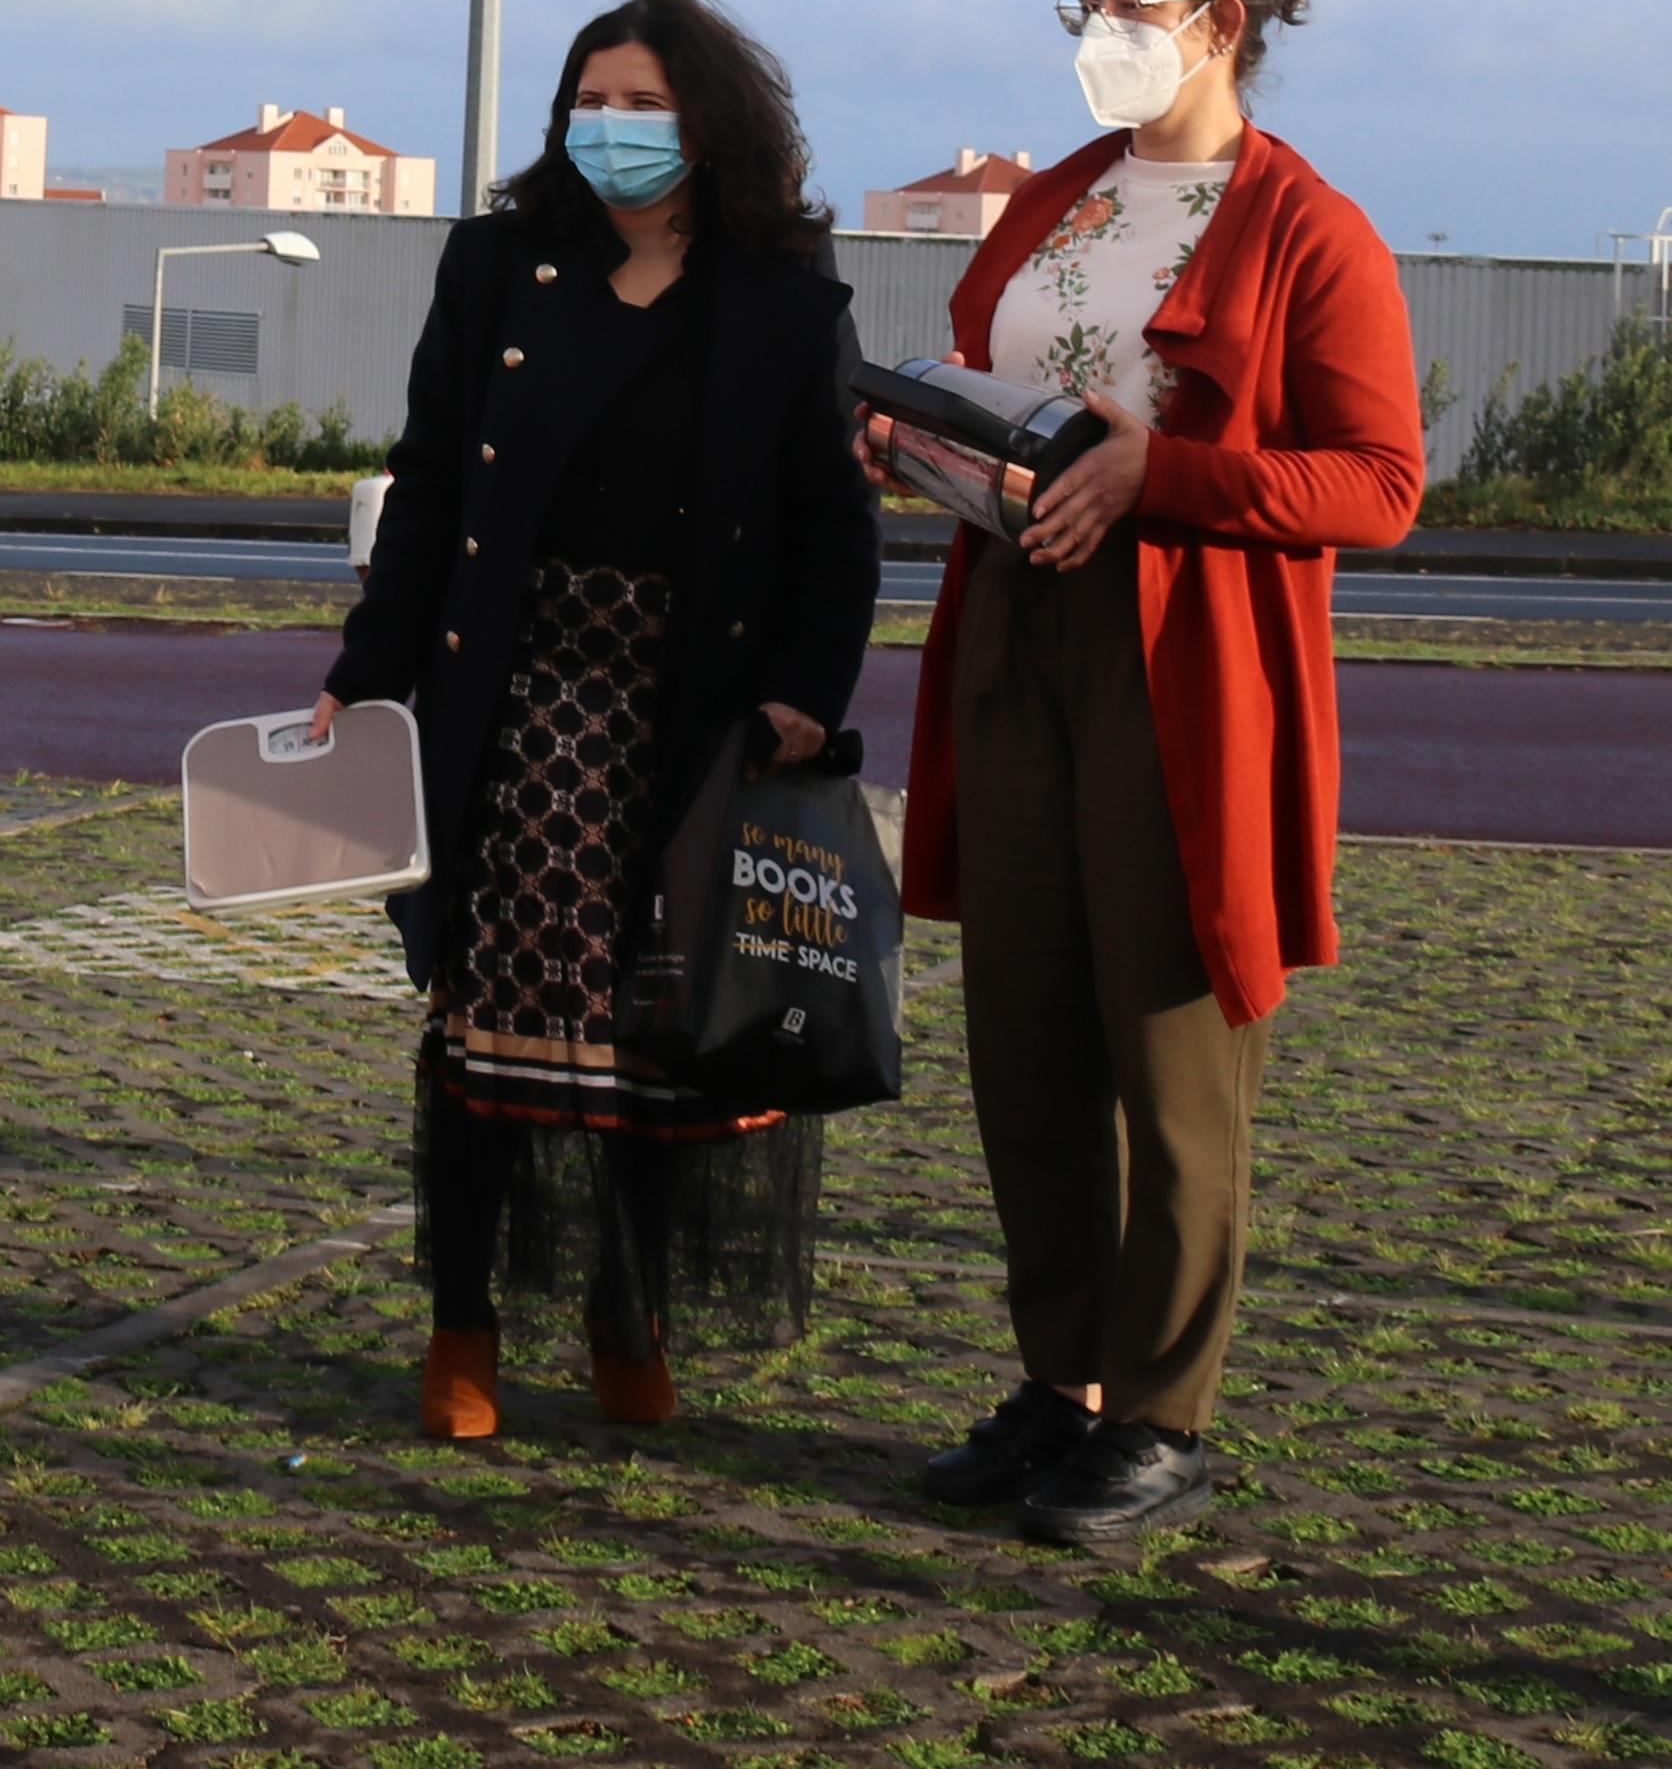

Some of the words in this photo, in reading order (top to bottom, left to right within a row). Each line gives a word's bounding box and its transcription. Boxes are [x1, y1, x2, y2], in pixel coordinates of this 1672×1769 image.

[733, 848, 858, 920] BOOKS
[773, 834, 846, 884] many
[745, 898, 774, 925] so
[782, 888, 849, 949] little
[734, 932, 792, 963] TIME
[797, 945, 858, 983] SPACE
